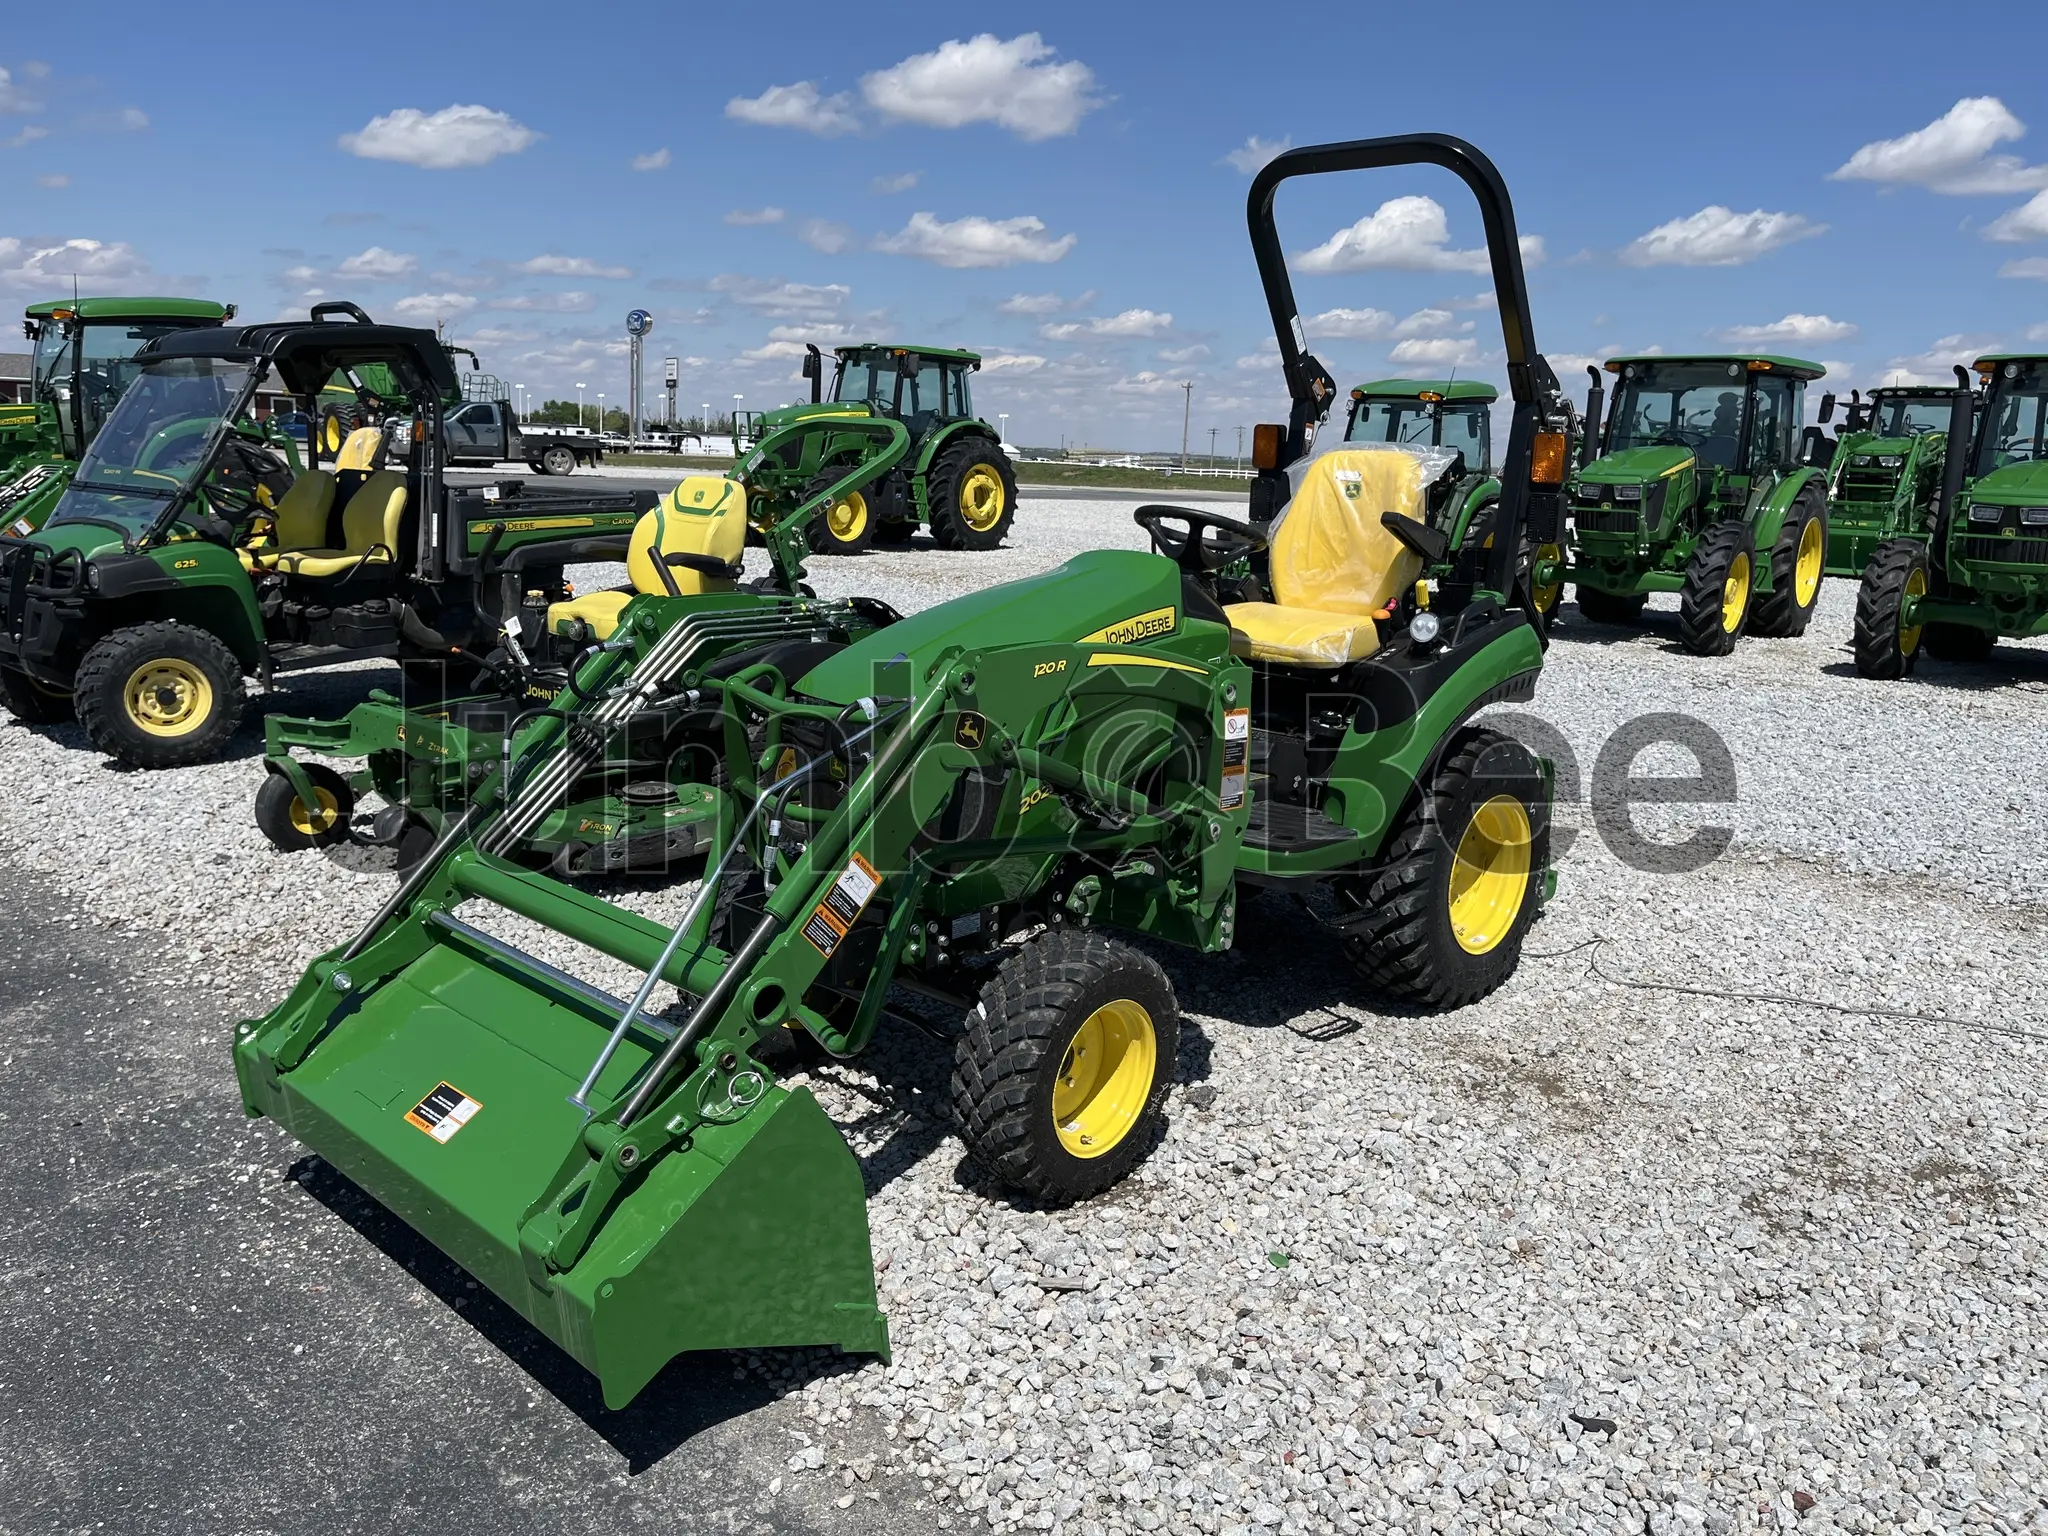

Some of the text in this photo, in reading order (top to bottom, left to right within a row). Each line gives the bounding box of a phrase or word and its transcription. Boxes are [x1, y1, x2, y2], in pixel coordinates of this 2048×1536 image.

[507, 522, 535, 530] DEERE
[1105, 616, 1171, 644] JOHN DEERE
[526, 683, 552, 701] JOHN
